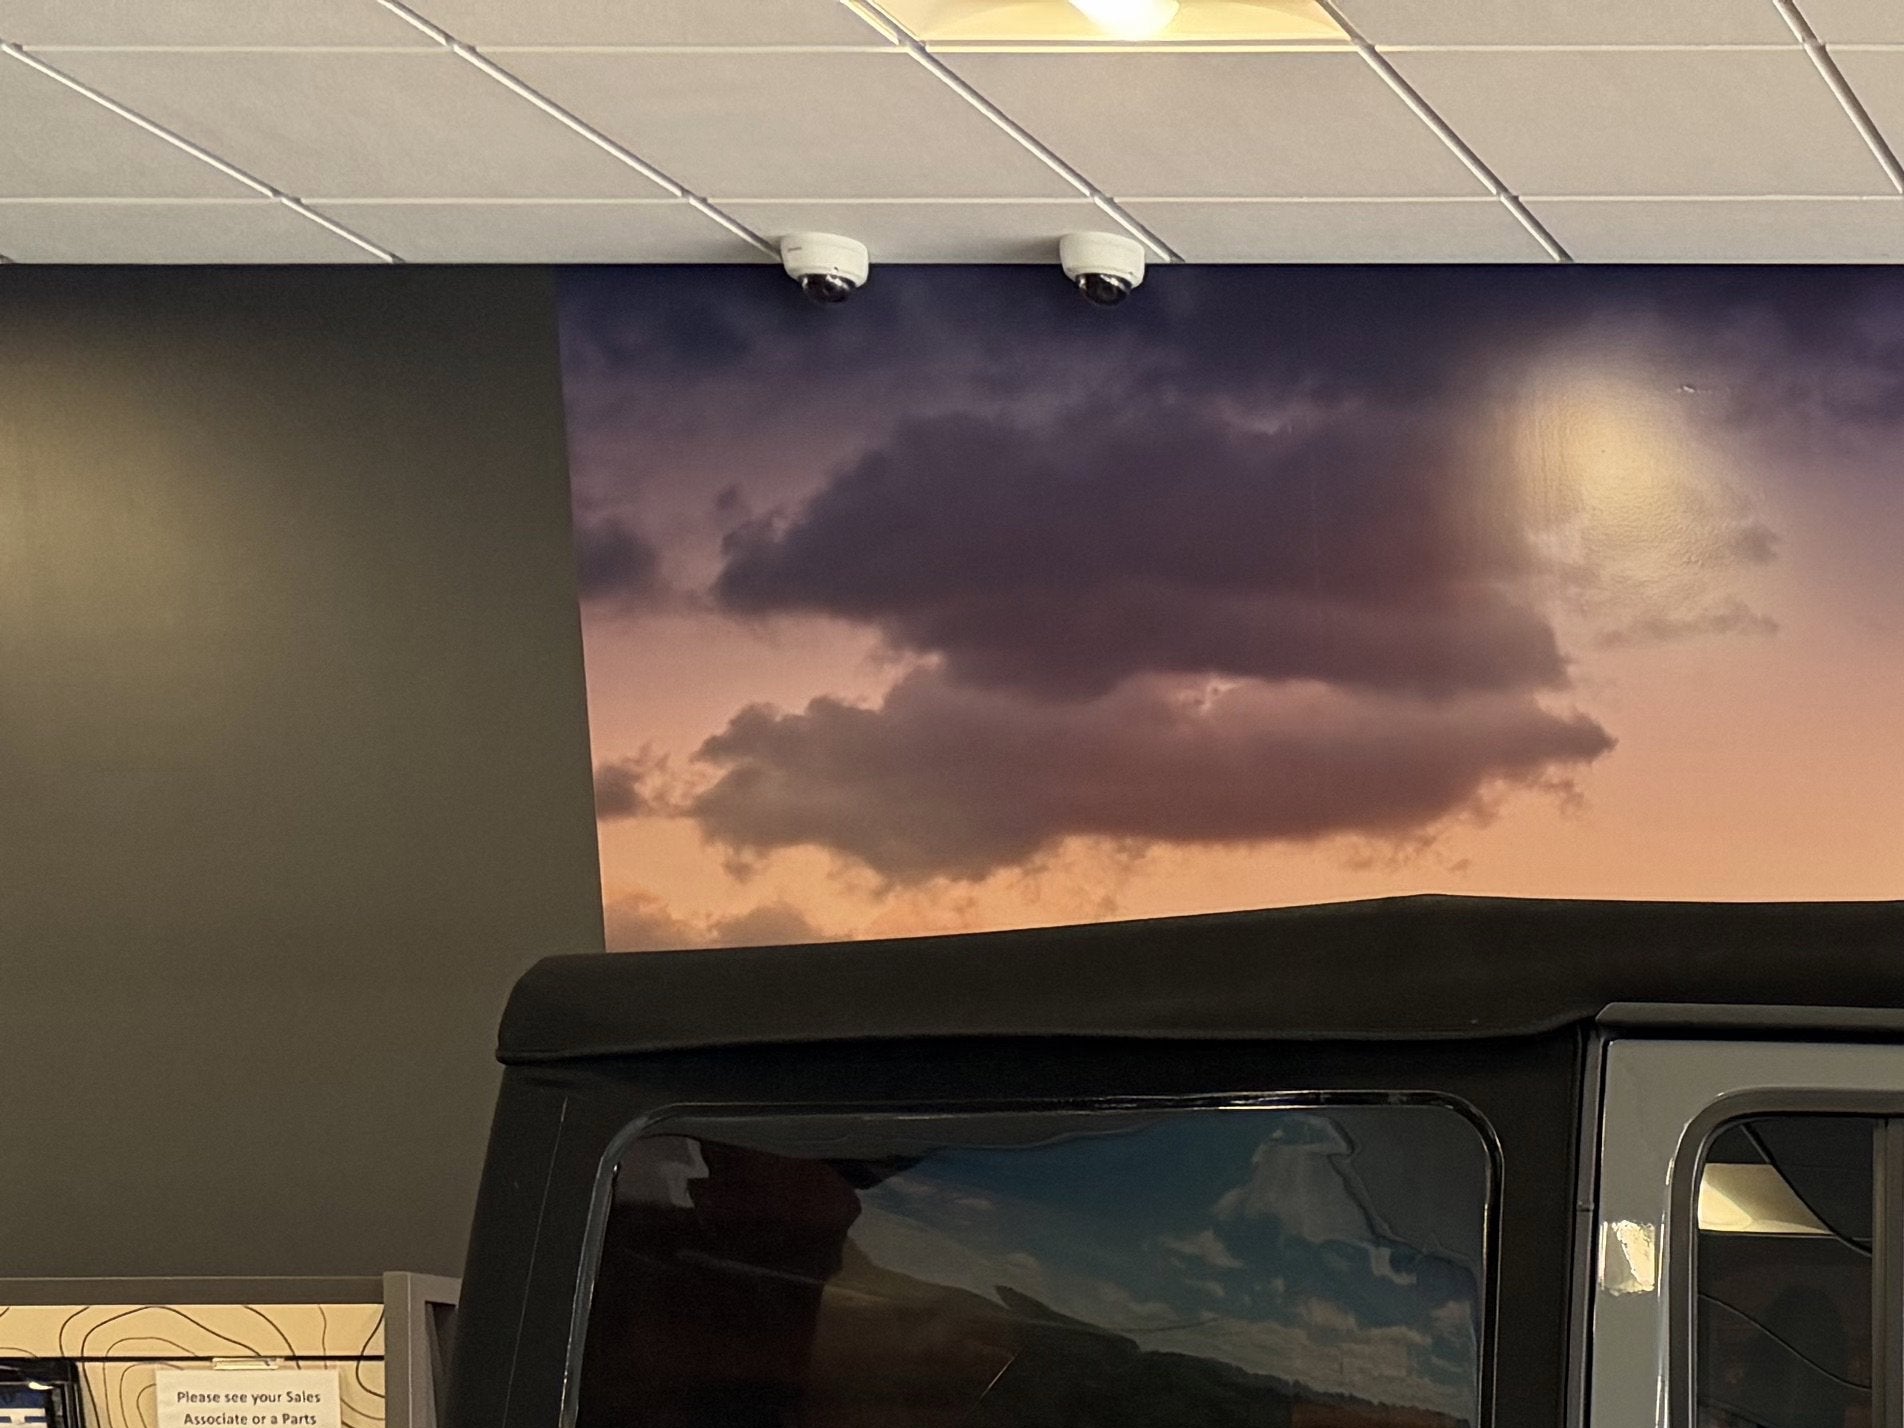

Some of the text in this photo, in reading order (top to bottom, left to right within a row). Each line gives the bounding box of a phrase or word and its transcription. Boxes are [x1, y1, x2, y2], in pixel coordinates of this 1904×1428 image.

[177, 1390, 321, 1406] Please see your Sales
[184, 1413, 317, 1425] Associate or a Parts
